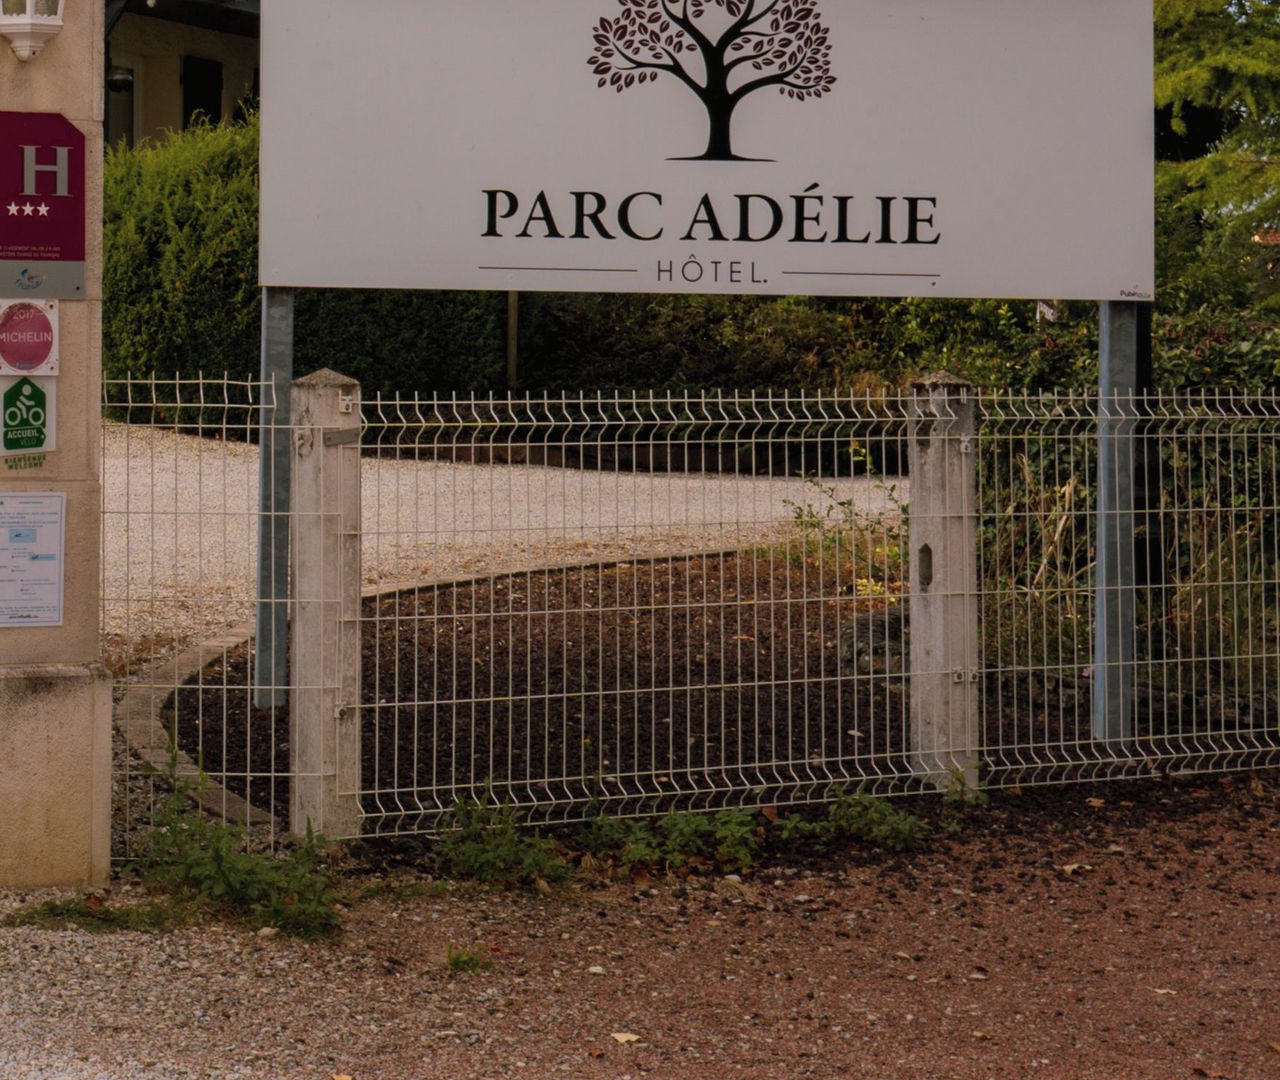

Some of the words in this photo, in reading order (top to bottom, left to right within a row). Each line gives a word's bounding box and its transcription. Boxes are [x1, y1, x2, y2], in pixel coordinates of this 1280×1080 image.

[18, 144, 74, 197] H
[480, 188, 664, 241] PARC
[679, 182, 942, 245] ADÉLIE
[12, 310, 34, 320] 2017
[7, 429, 39, 439] ACCUEIL
